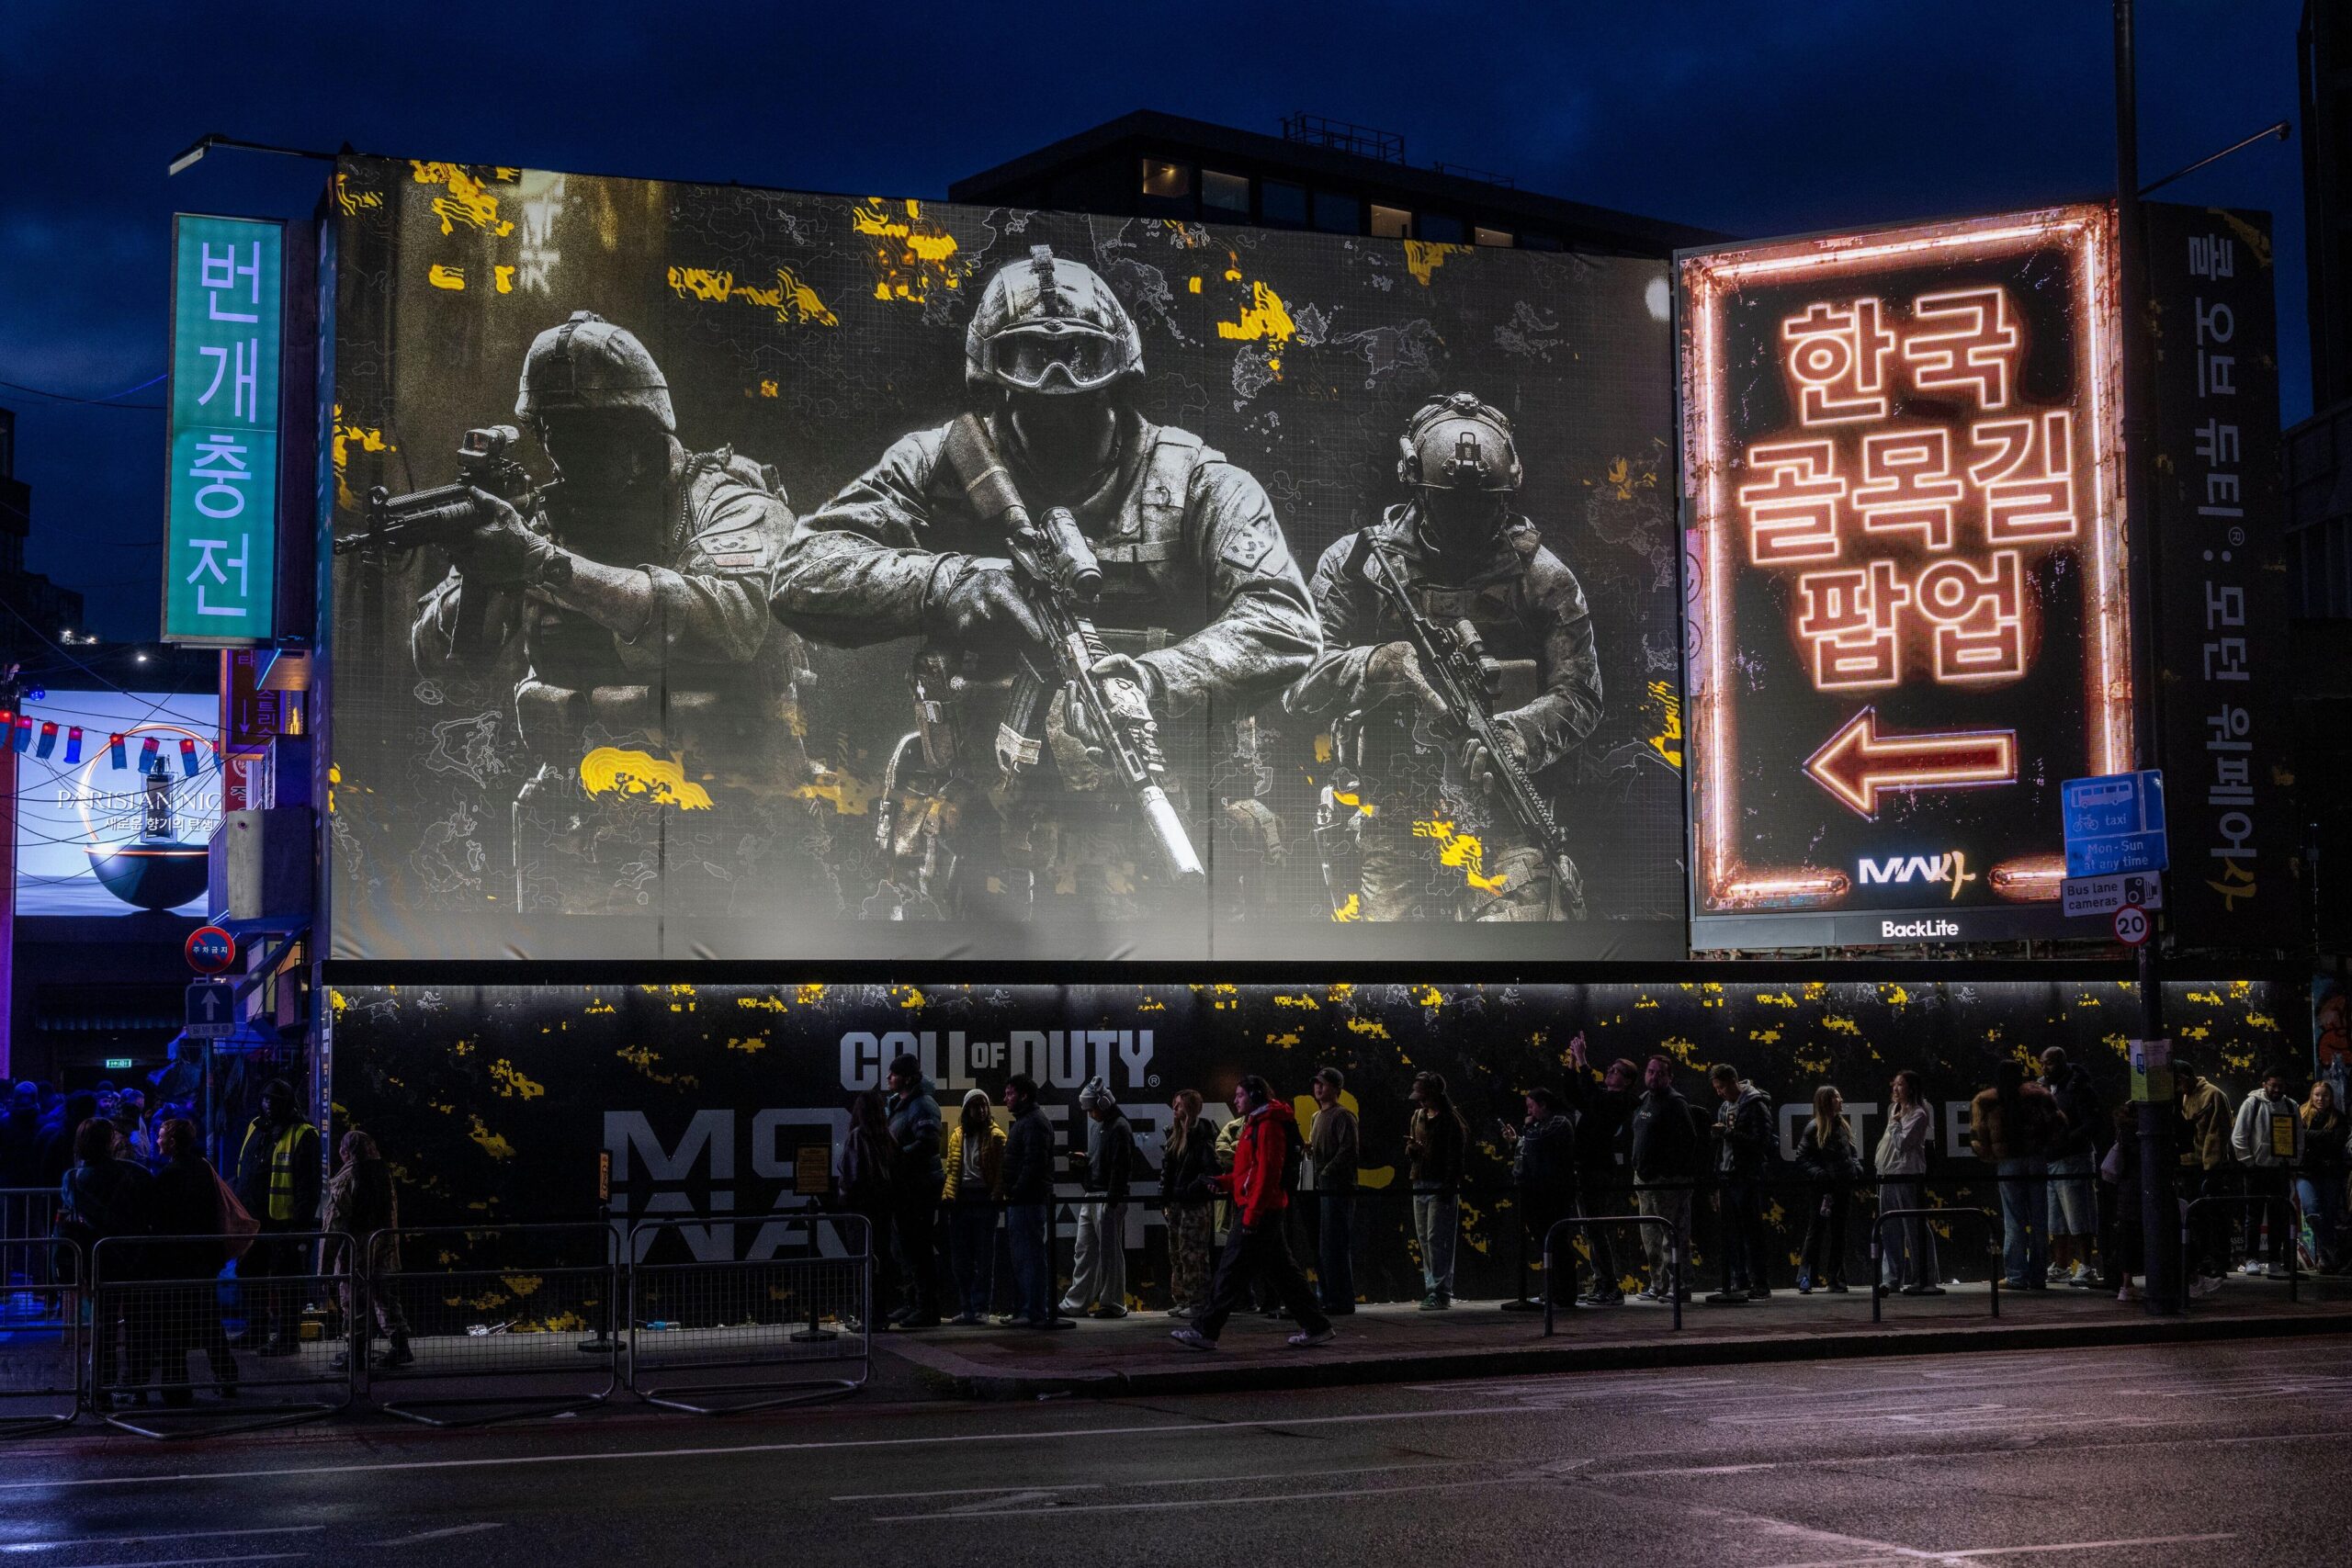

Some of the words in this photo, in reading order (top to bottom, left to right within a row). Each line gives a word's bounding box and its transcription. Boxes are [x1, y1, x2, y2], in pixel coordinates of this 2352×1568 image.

[2188, 232, 2234, 282] 콜
[1782, 286, 2018, 427] 한국
[186, 241, 261, 617] 번개충전
[1738, 409, 2078, 565] 골목길
[1798, 548, 2024, 691] 팝업
[2203, 580, 2251, 682] 모던
[57, 789, 173, 810] PARISIAN
[146, 817, 186, 832] 향기의
[2105, 813, 2127, 827] taxi
[2084, 860, 2096, 871] at
[2099, 860, 2120, 872] any
[2122, 855, 2149, 867] time
[2067, 885, 2089, 897] Bus
[2093, 882, 2118, 894] lane
[2068, 896, 2118, 910] cameras
[1882, 919, 1960, 938] BackLite
[2118, 916, 2145, 935] 20
[192, 945, 228, 954] 주차금지
[971, 1042, 1006, 1069] OF
